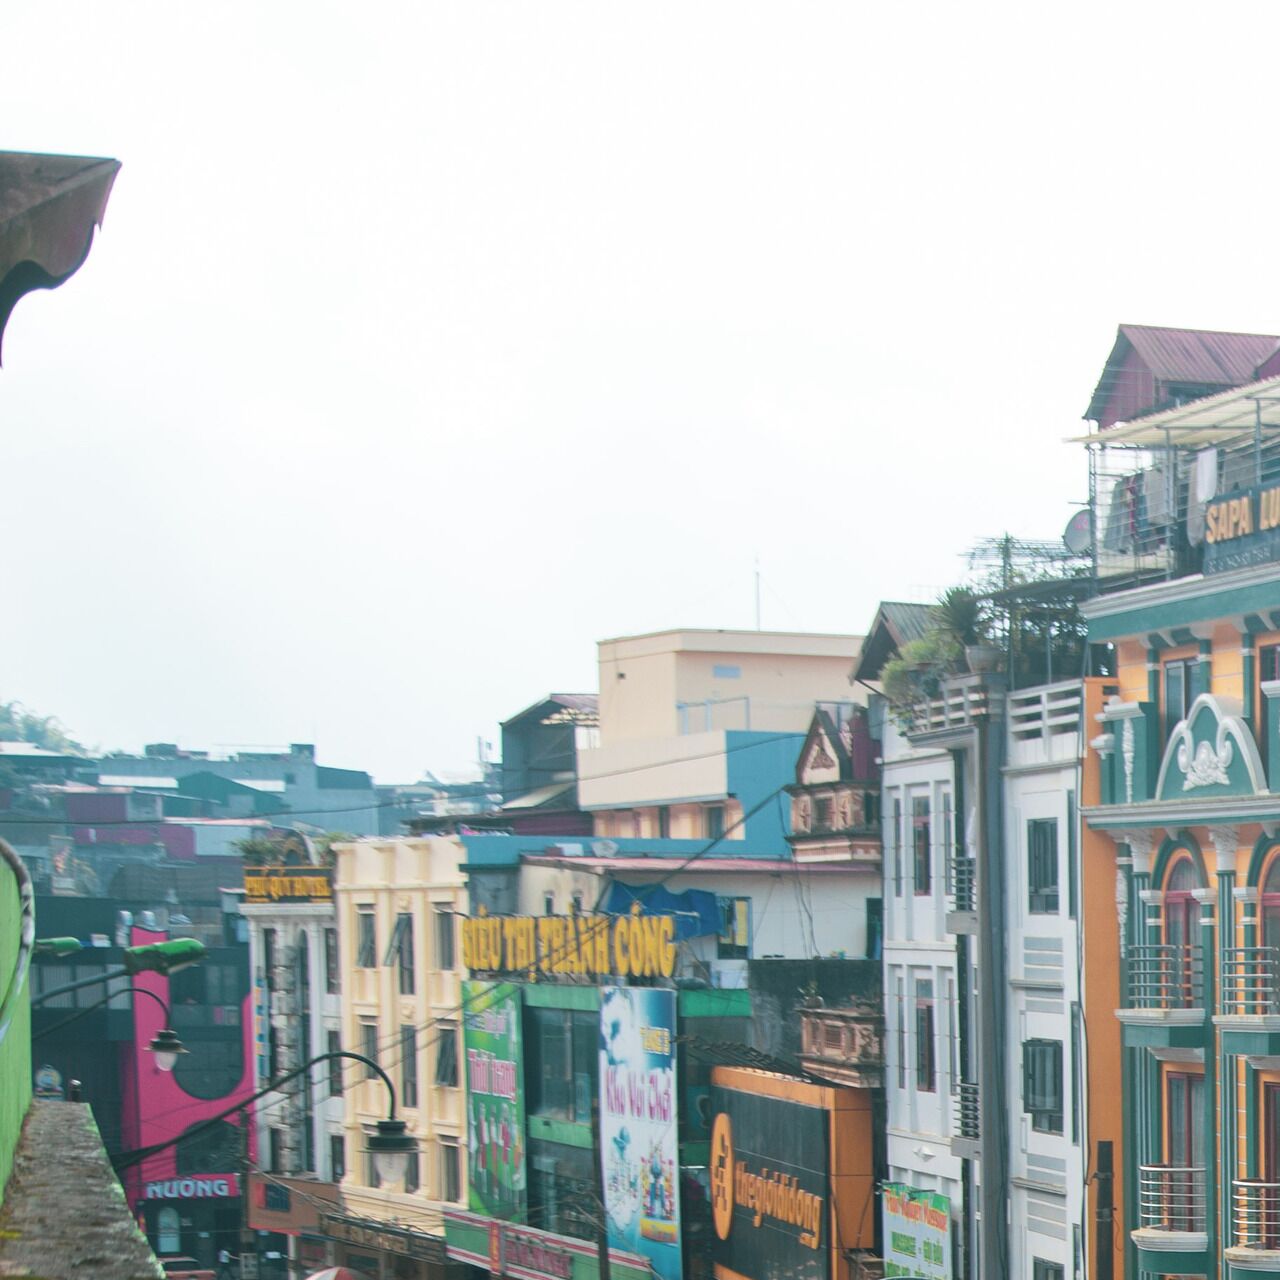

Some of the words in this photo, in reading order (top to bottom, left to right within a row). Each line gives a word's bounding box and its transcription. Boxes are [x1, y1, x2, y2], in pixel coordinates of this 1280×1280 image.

[1206, 496, 1253, 544] SAPA
[463, 904, 501, 970] SIÊU
[503, 916, 536, 983] THỊ
[614, 901, 675, 977] CÔNG
